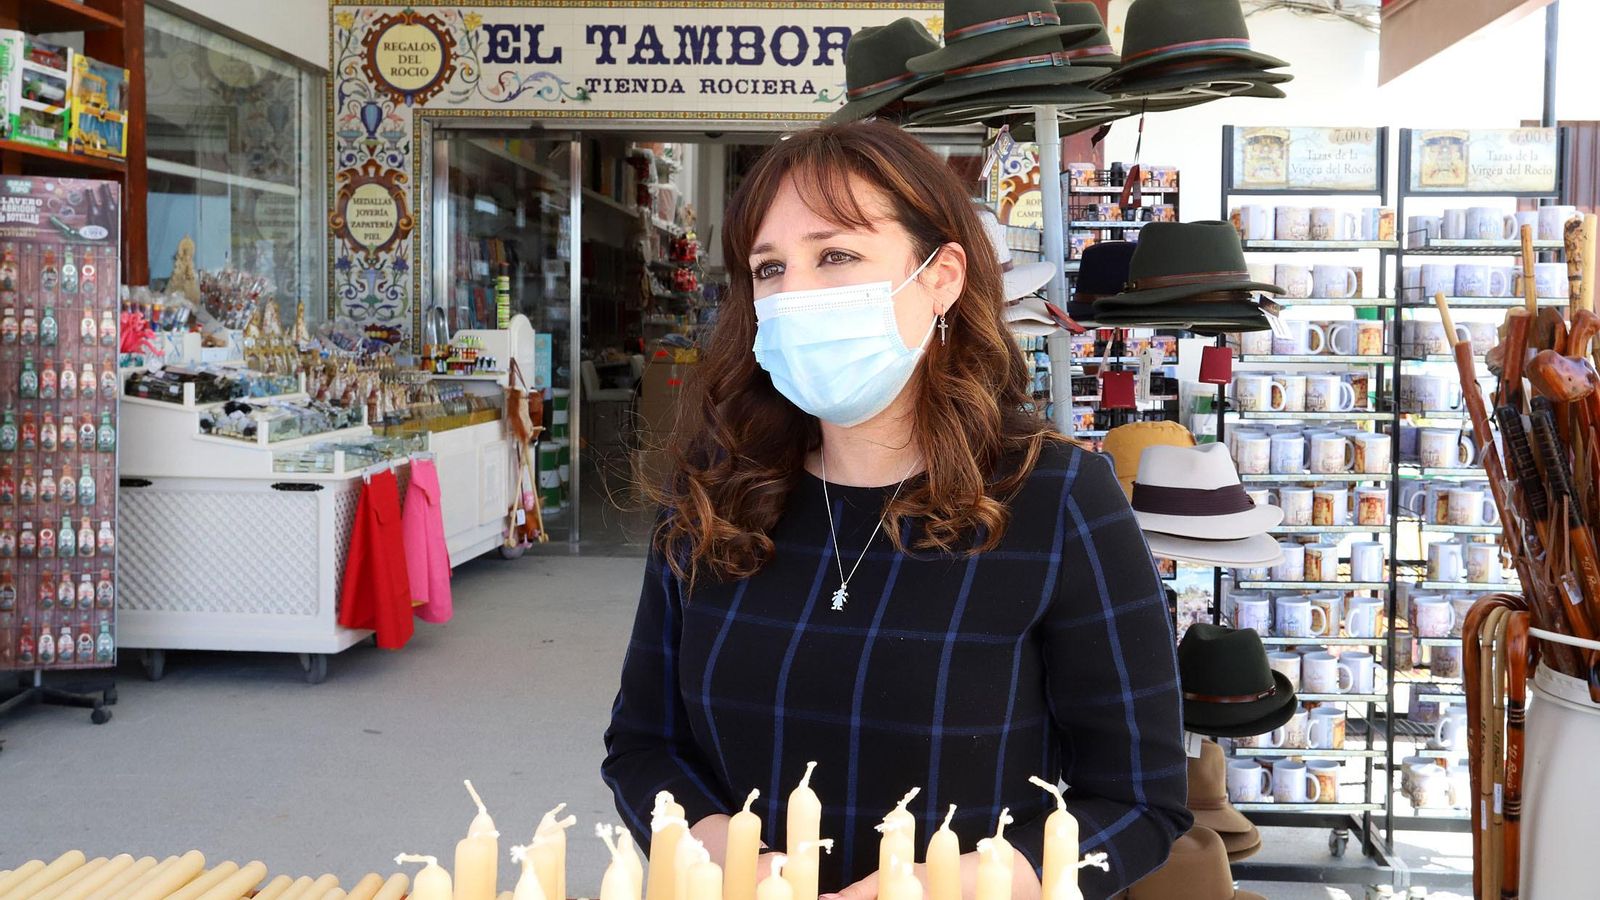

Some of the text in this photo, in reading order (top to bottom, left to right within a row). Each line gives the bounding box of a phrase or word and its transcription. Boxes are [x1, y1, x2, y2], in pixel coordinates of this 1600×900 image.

[383, 42, 437, 52] REGALOS
[482, 23, 864, 67] EL TAMBOR
[398, 55, 422, 65] DEL
[390, 67, 430, 77] ROCIO
[585, 78, 817, 95] TIENDA ROCIERA
[1326, 162, 1341, 175] del
[1471, 164, 1503, 178] Virgen
[1506, 163, 1521, 176] del
[352, 197, 393, 206] MEDALLAS
[351, 220, 394, 229] ZAPATERÍA
[364, 232, 381, 241] PIEL
